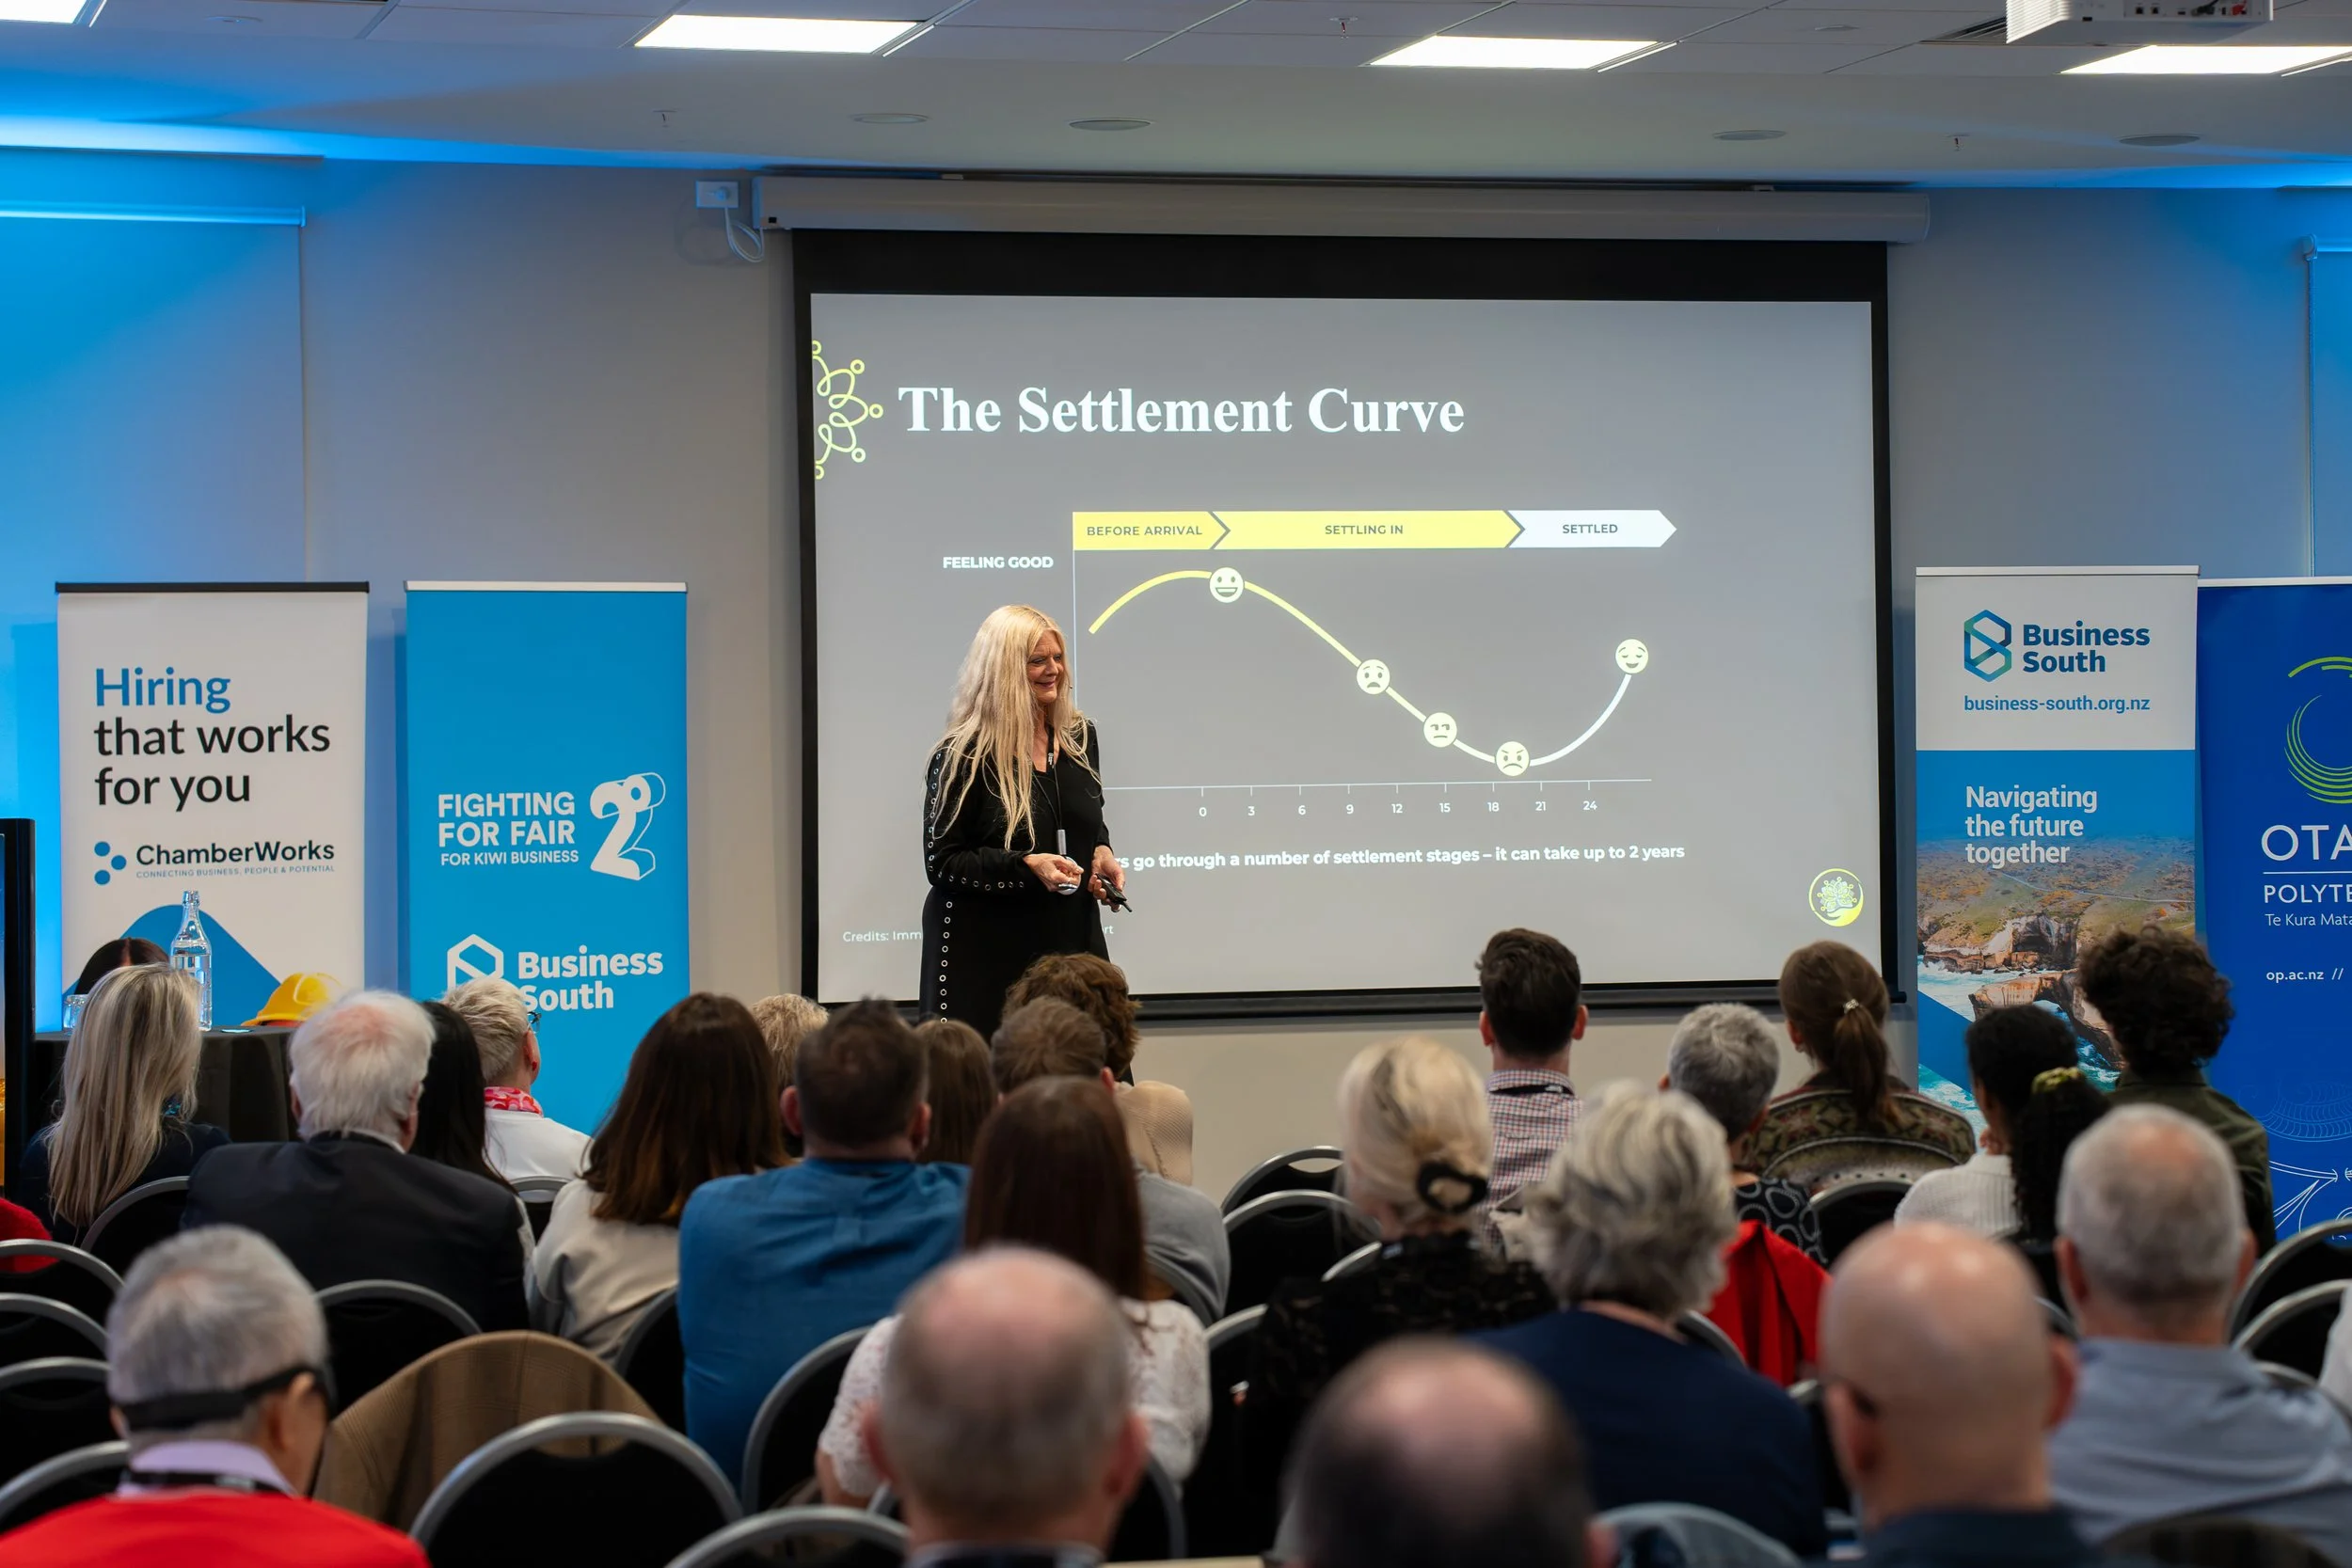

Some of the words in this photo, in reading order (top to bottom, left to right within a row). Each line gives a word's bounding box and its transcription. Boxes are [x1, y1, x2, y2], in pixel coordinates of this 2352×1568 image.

[898, 387, 1001, 433] The
[1018, 387, 1293, 433] Settlement
[1309, 387, 1464, 433] Curve
[1087, 526, 1139, 536] BEFORE
[1144, 525, 1202, 535] ARRIVAL
[1325, 525, 1387, 535] SETTLING
[1391, 525, 1403, 534] IN
[1563, 524, 1617, 534] SETTLED
[943, 556, 1005, 569] FEELING
[1008, 556, 1054, 569] GOOD
[2023, 621, 2150, 646] Business
[2023, 650, 2106, 673] South
[96, 667, 230, 713] Hiring
[1964, 695, 2150, 713] business-south.org.nz
[94, 717, 184, 755] that
[196, 714, 330, 753] works
[95, 767, 160, 806] for
[169, 773, 250, 812] you
[1965, 784, 2097, 813] Navigating
[438, 791, 576, 818] FIGHTING
[1199, 806, 1207, 817] 0
[1248, 806, 1255, 816] 3
[1298, 805, 1307, 816] 6
[1346, 804, 1354, 815] 9
[1391, 803, 1403, 814] 12
[1439, 802, 1451, 813] 15
[1487, 801, 1499, 812] 18
[1535, 801, 1547, 812] 21
[1582, 800, 1597, 811] 24
[438, 821, 500, 847] FOR
[510, 820, 576, 846] FAIR
[1965, 814, 2005, 836] the
[2010, 814, 2084, 836] future
[136, 840, 335, 865] ChamberWorks
[1965, 840, 2070, 869] together
[2261, 824, 2352, 862] OTA
[441, 852, 470, 866] FOR
[474, 851, 507, 865] KIWI
[511, 850, 579, 864] BUSINESS
[1133, 857, 1155, 871] go
[1159, 852, 1225, 870] through
[1230, 856, 1239, 866] a
[1245, 851, 1309, 865] number
[1313, 849, 1330, 864] of
[1333, 848, 1422, 863] settlement
[1426, 849, 1479, 864] stages
[1496, 847, 1507, 862] it
[1511, 848, 1540, 861] can
[1544, 846, 1580, 861] take
[1584, 847, 1605, 863] up
[1609, 846, 1625, 860] to
[1629, 846, 1639, 859] 2
[1642, 846, 1685, 862] years
[136, 869, 195, 879] CONNECTING
[197, 867, 242, 877] BUSINESS,
[245, 866, 278, 875] PEOPLE
[2265, 913, 2281, 927] Te
[2285, 913, 2316, 926] Kura
[843, 930, 889, 942] Credits:
[517, 944, 663, 979] Business
[2266, 971, 2324, 983] op.ac.nz
[519, 980, 614, 1011] South
